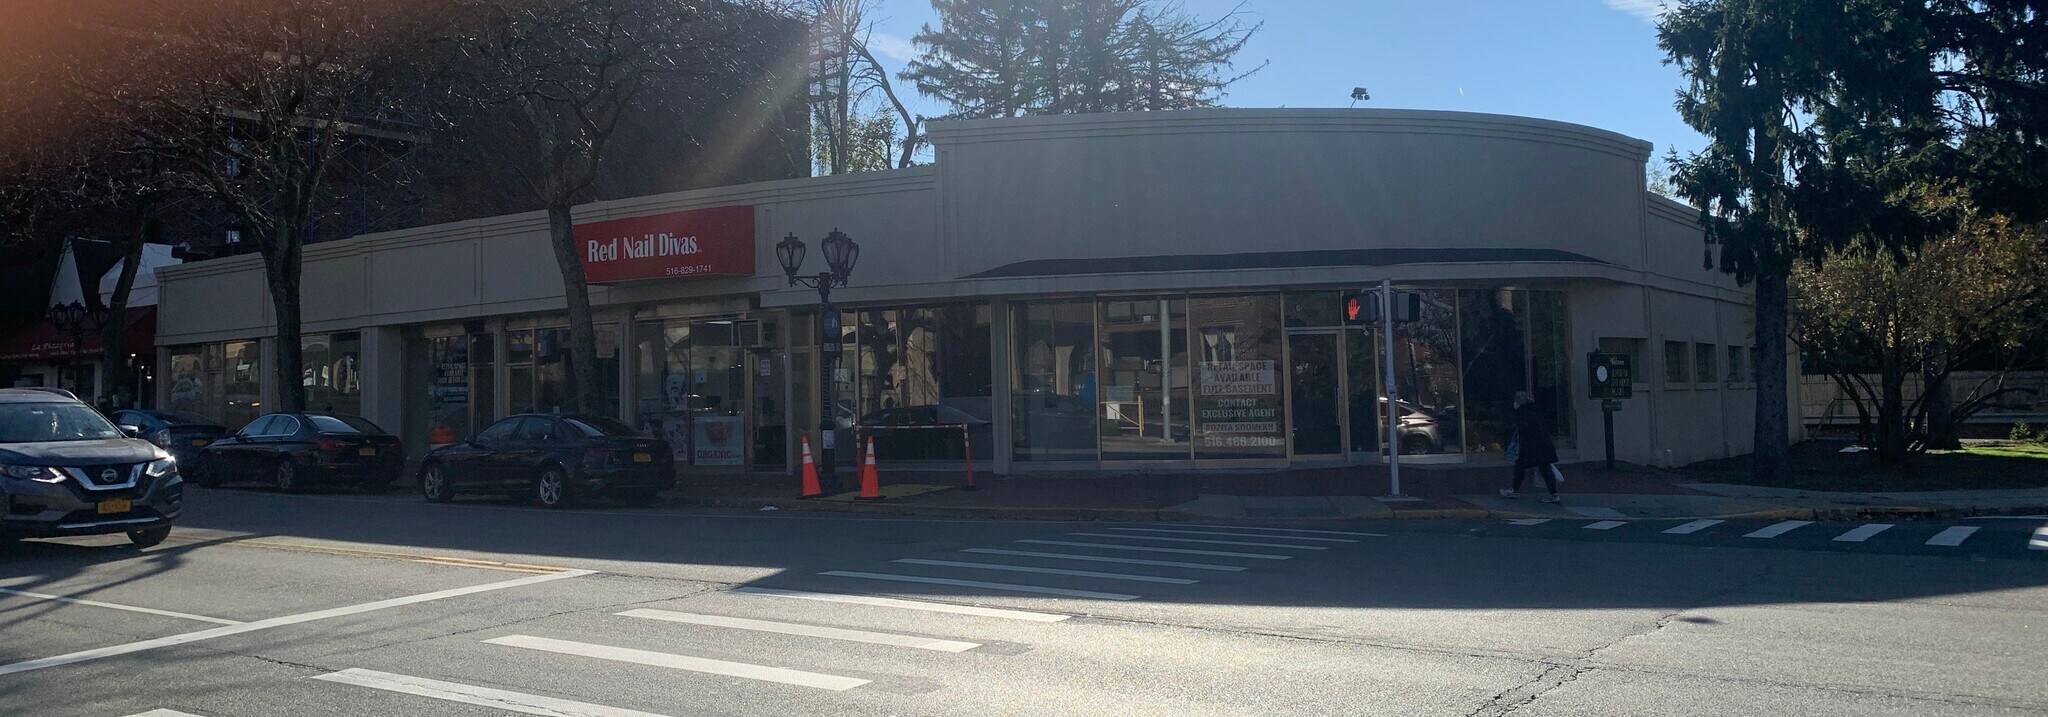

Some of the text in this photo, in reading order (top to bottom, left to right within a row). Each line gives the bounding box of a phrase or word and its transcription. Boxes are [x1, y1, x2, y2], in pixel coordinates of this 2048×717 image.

[588, 232, 697, 262] Red Nail Divas
[666, 264, 712, 275] 516-829-1741
[1207, 361, 1267, 371] RETAIL SPACE
[1214, 373, 1261, 382] AVAILABLE
[1203, 384, 1272, 394] FULL BASEMENT
[1218, 399, 1257, 407] CONTACT
[1202, 408, 1276, 418] EXCLUSIVE AGENT
[697, 449, 732, 459] ORGANIC
